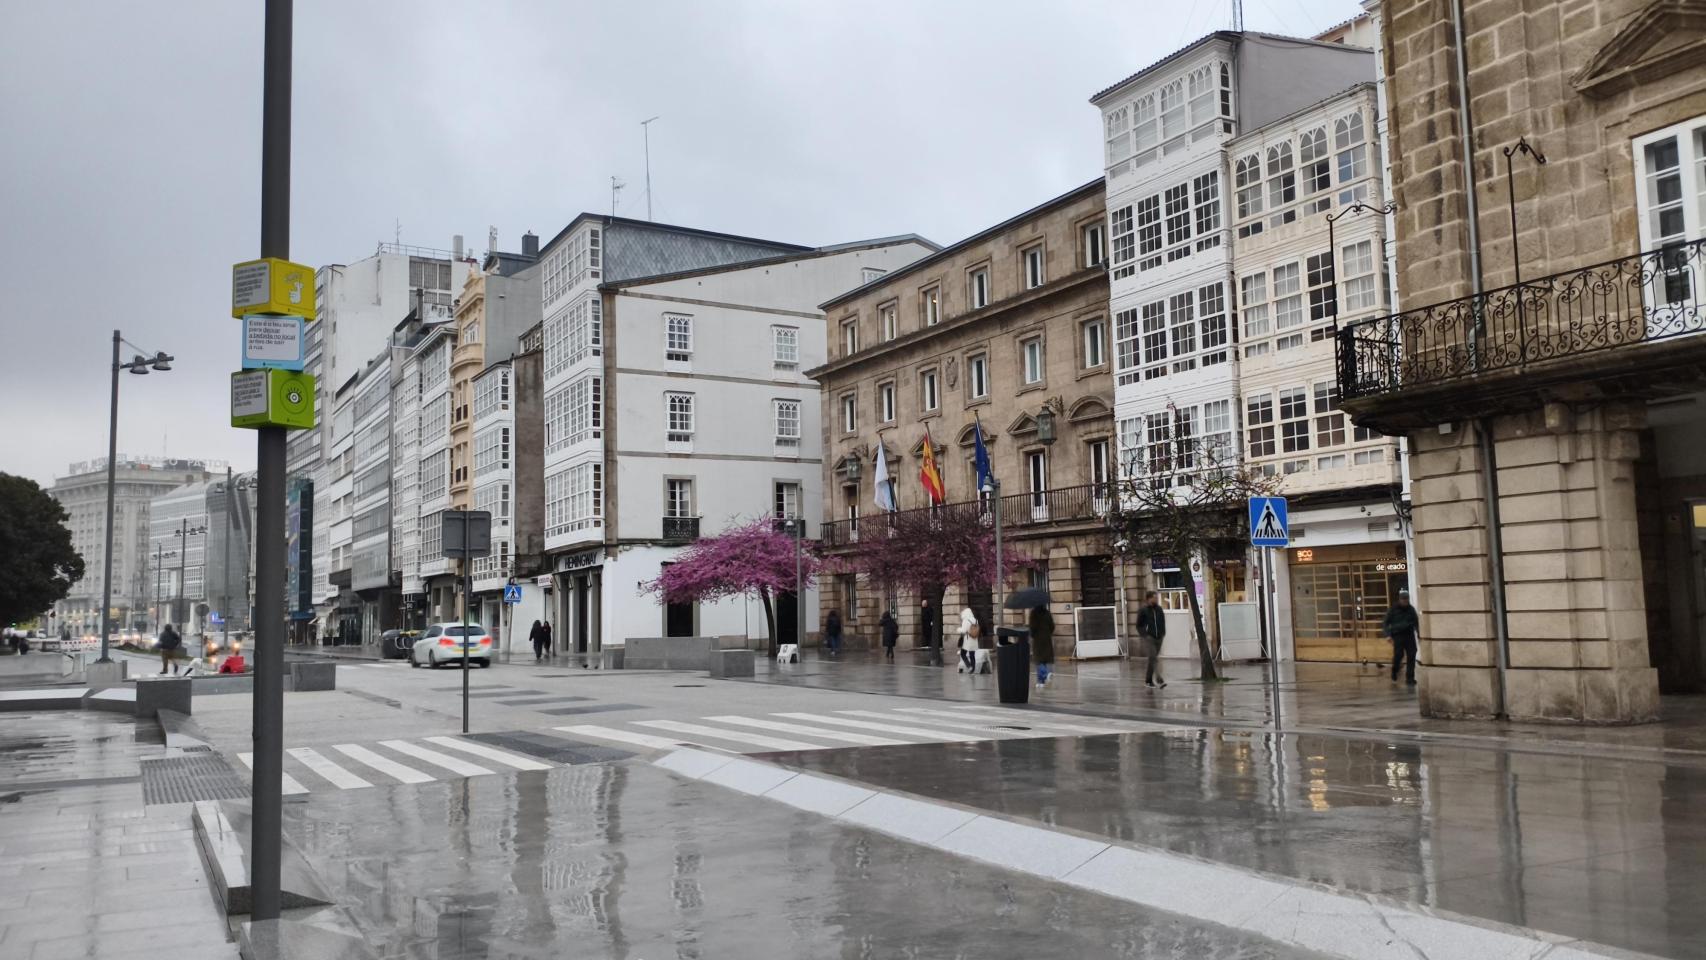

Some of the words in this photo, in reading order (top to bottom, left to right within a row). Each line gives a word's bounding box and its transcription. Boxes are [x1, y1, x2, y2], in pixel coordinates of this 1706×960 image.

[187, 458, 230, 468] PASTOR
[564, 551, 598, 570] HEMINGWAY
[1376, 563, 1385, 571] de
